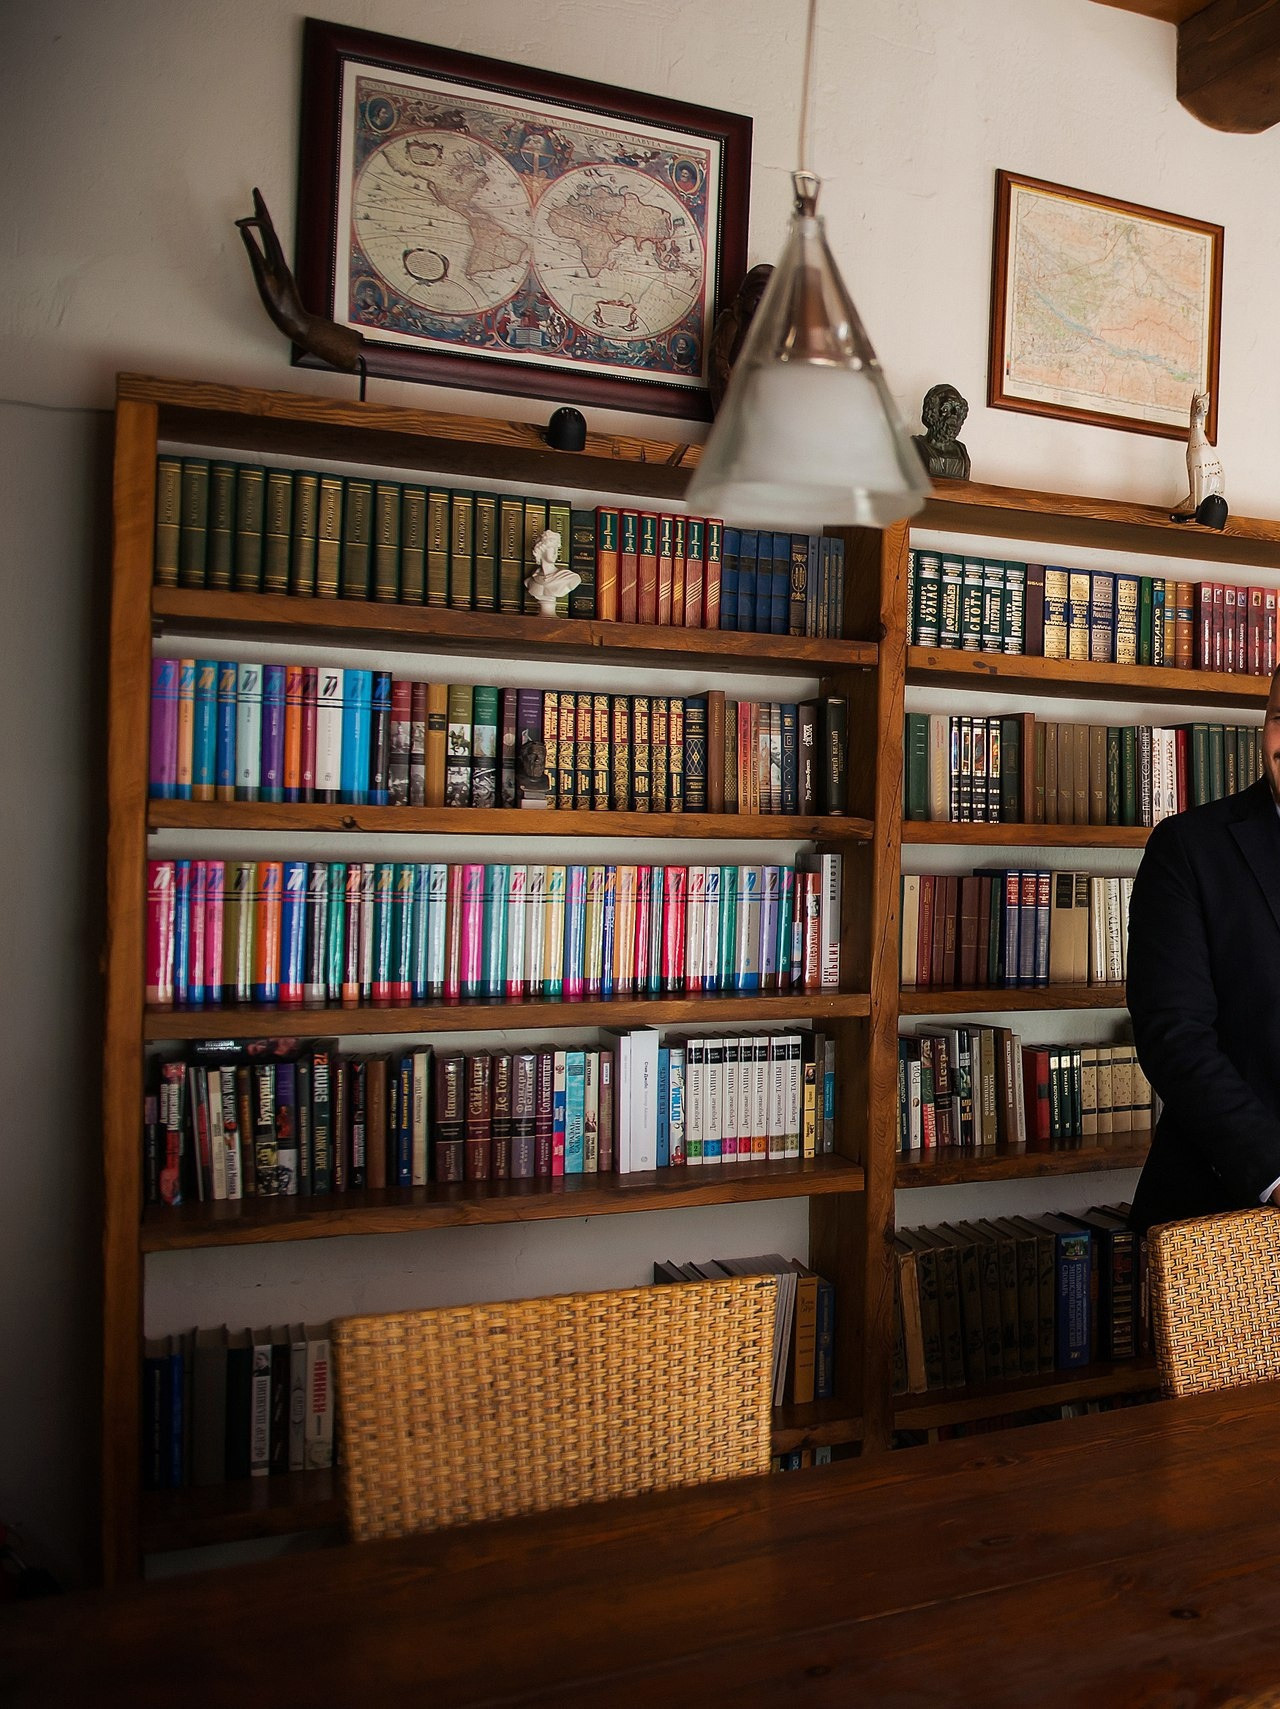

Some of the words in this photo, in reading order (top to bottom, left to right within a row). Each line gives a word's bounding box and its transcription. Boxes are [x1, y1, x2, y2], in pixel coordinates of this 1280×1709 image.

[926, 584, 937, 622] УЭЛЛС
[946, 584, 955, 631] АФАНАСЬЕВ
[970, 590, 981, 631] СКОТТ
[990, 597, 1000, 633] ЕКАТЕРИНА
[1012, 591, 1022, 636] КРОПОТКИН
[829, 942, 838, 983] ЕЛЬЦИН
[222, 1072, 236, 1093] MEDIA
[471, 1062, 484, 1114] Самарин
[516, 1062, 525, 1113] Фридрих
[541, 1060, 552, 1112] Солженицын
[912, 1065, 920, 1084] РОЙ
[938, 1054, 948, 1086] Петр
[160, 1084, 168, 1124] Александр
[168, 1084, 178, 1130] Коржаков
[222, 1095, 237, 1122] SAPIENS
[257, 1077, 273, 1125] Бухарин
[444, 1074, 456, 1117] Николай
[496, 1097, 508, 1111] Де
[671, 1087, 680, 1121] ПУТИНА
[742, 1095, 750, 1129] Дворцовые
[316, 1126, 327, 1150] FRANK
[316, 1152, 326, 1170] POPE
